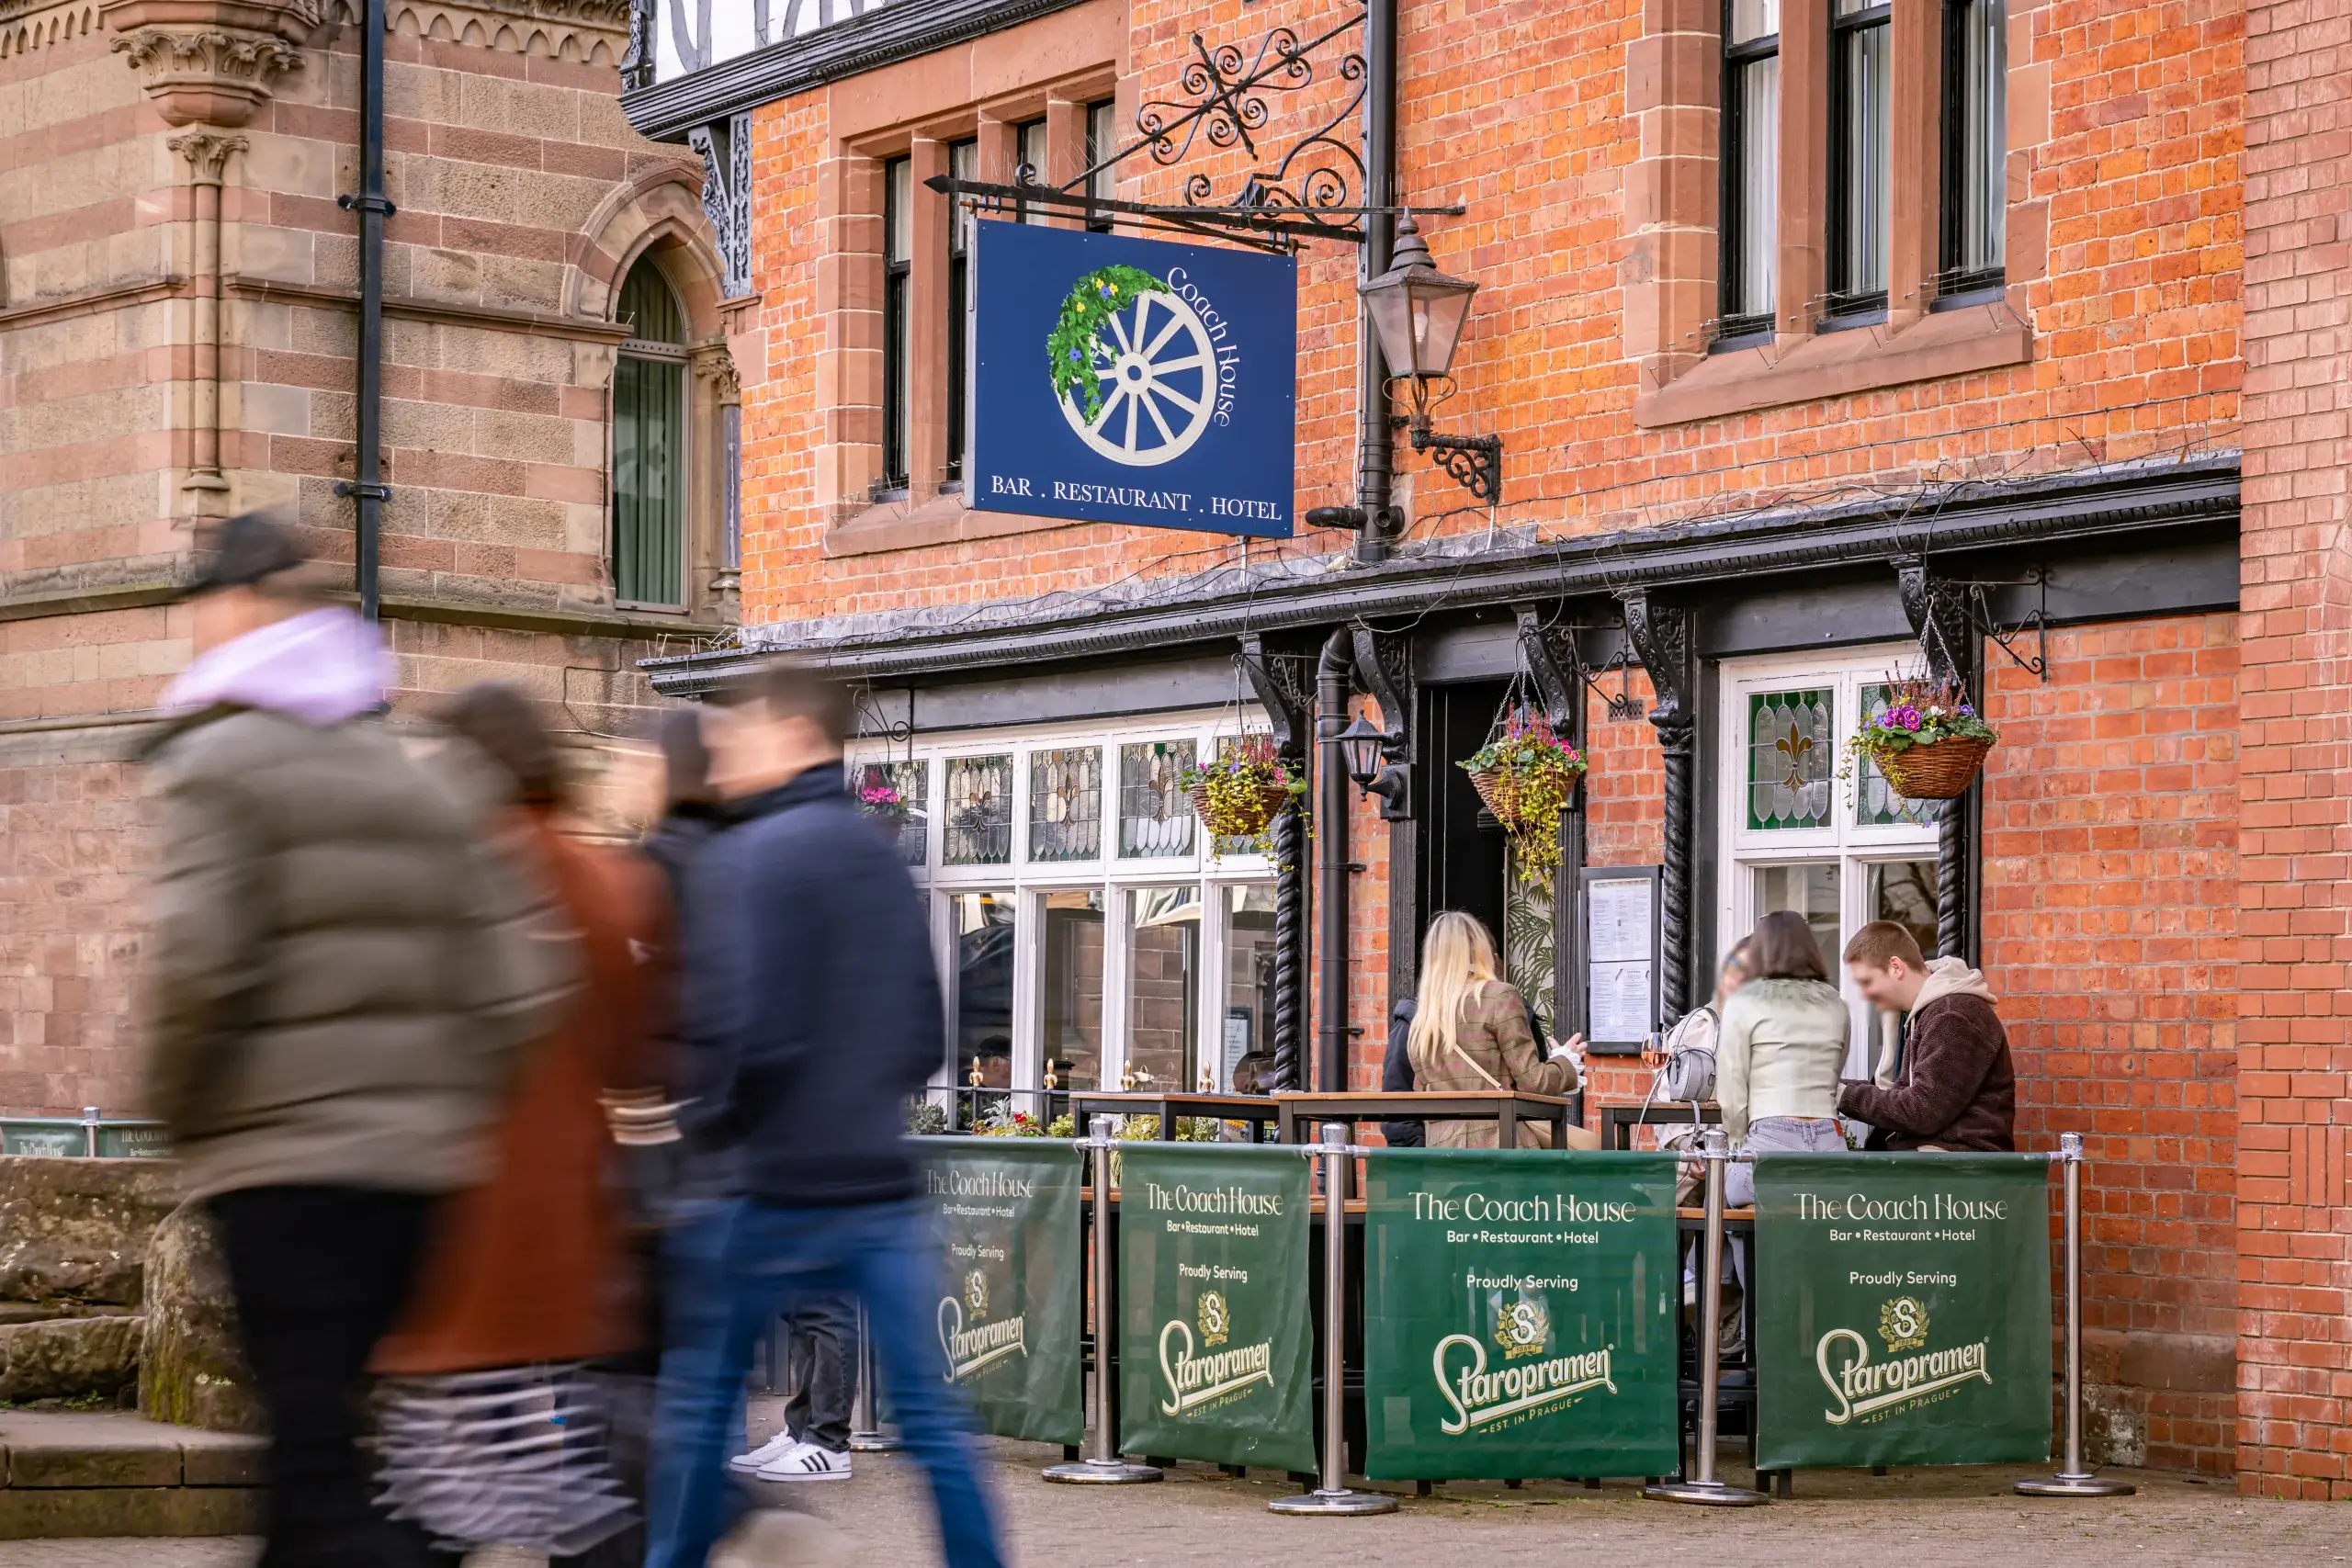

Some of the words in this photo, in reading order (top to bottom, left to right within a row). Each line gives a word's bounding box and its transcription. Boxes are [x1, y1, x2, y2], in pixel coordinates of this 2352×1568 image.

[1167, 266, 1228, 342] Coach
[1214, 344, 1240, 427] House
[990, 475, 1034, 497] BAR
[1053, 480, 1192, 512] RESTAURANT
[1211, 496, 1283, 521] HOTEL
[924, 1168, 949, 1194] The
[949, 1169, 989, 1196] Coach
[992, 1171, 1035, 1198] House
[943, 1203, 954, 1213] Bar
[956, 1204, 990, 1216] Restaurant
[995, 1206, 1015, 1217] Hotel
[1146, 1182, 1175, 1211] The
[1175, 1184, 1227, 1213] Coach
[1229, 1186, 1284, 1215] House
[1408, 1191, 1460, 1221] The
[1464, 1192, 1550, 1222] Coach
[1555, 1194, 1636, 1223] House
[1793, 1193, 1842, 1220] The
[1847, 1193, 1928, 1221] Coach
[1935, 1193, 2008, 1220] House
[1167, 1220, 1181, 1232] Bar
[1185, 1221, 1229, 1235] Restaurant
[1235, 1224, 1259, 1236] Hotel
[1447, 1230, 1470, 1243] Bar
[1480, 1231, 1554, 1244] Restaurant
[1564, 1231, 1599, 1244] Hotel
[1829, 1229, 1852, 1241] Bar
[1863, 1229, 1932, 1241] Restaurant
[1942, 1229, 1975, 1241] Hotel
[951, 1243, 977, 1259] Proudly
[978, 1245, 1004, 1261] Serving
[1179, 1263, 1211, 1280] Proudly
[1213, 1265, 1248, 1283] Serving
[1466, 1274, 1521, 1291] Proudly
[1525, 1274, 1578, 1292] Serving
[1849, 1271, 1903, 1287] Proudly
[1906, 1271, 1957, 1287] Serving
[937, 1296, 1028, 1383] Staropramen
[1159, 1320, 1275, 1416] Staropramen
[1816, 1328, 1993, 1425] Staropramen
[1432, 1334, 1617, 1435] Staropramen
[1209, 1401, 1218, 1412] IN
[1219, 1389, 1247, 1407] PRAGUE
[1871, 1410, 1890, 1423] EST.
[1895, 1404, 1905, 1416] IN
[1909, 1391, 1951, 1410] PRAGUE
[1489, 1419, 1510, 1433] EST.
[1514, 1415, 1525, 1425] IN
[1529, 1400, 1572, 1420] PRAGUE
